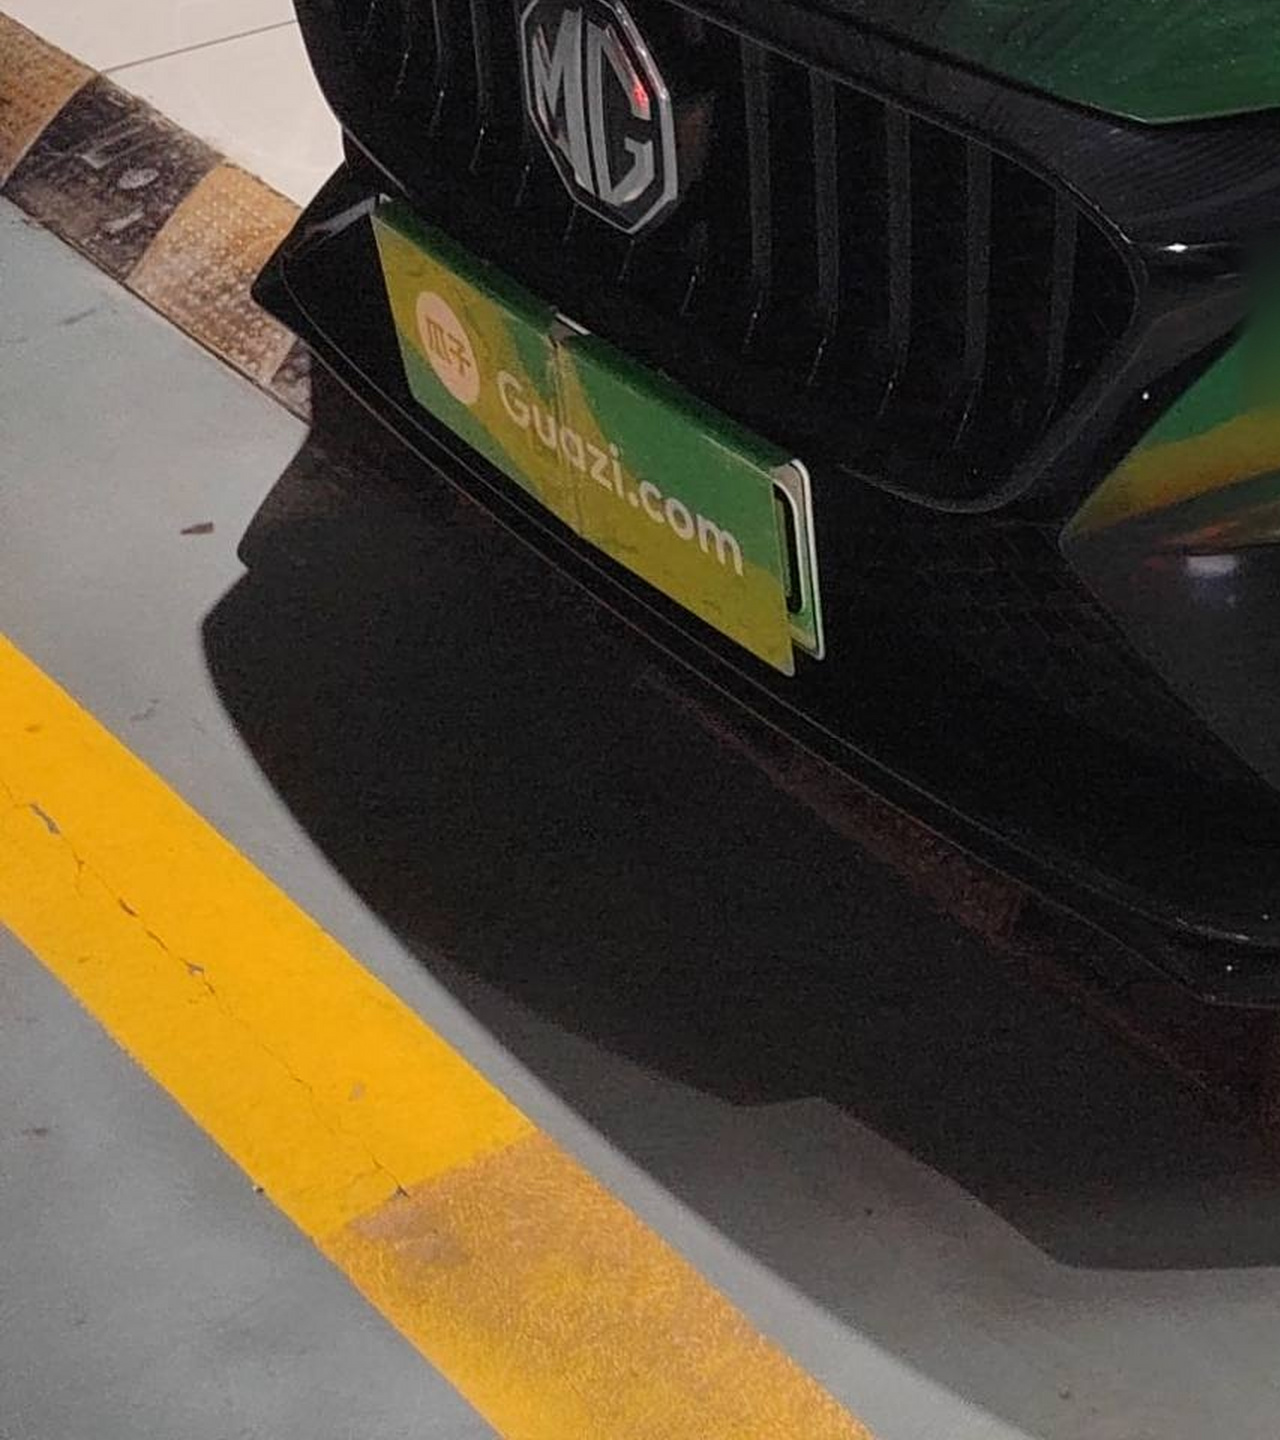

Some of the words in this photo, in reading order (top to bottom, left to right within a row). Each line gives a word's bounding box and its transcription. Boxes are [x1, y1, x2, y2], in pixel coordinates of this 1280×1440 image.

[532, 6, 655, 207] MG
[425, 316, 471, 376] 瓜子
[498, 370, 743, 577] Guazi.com
